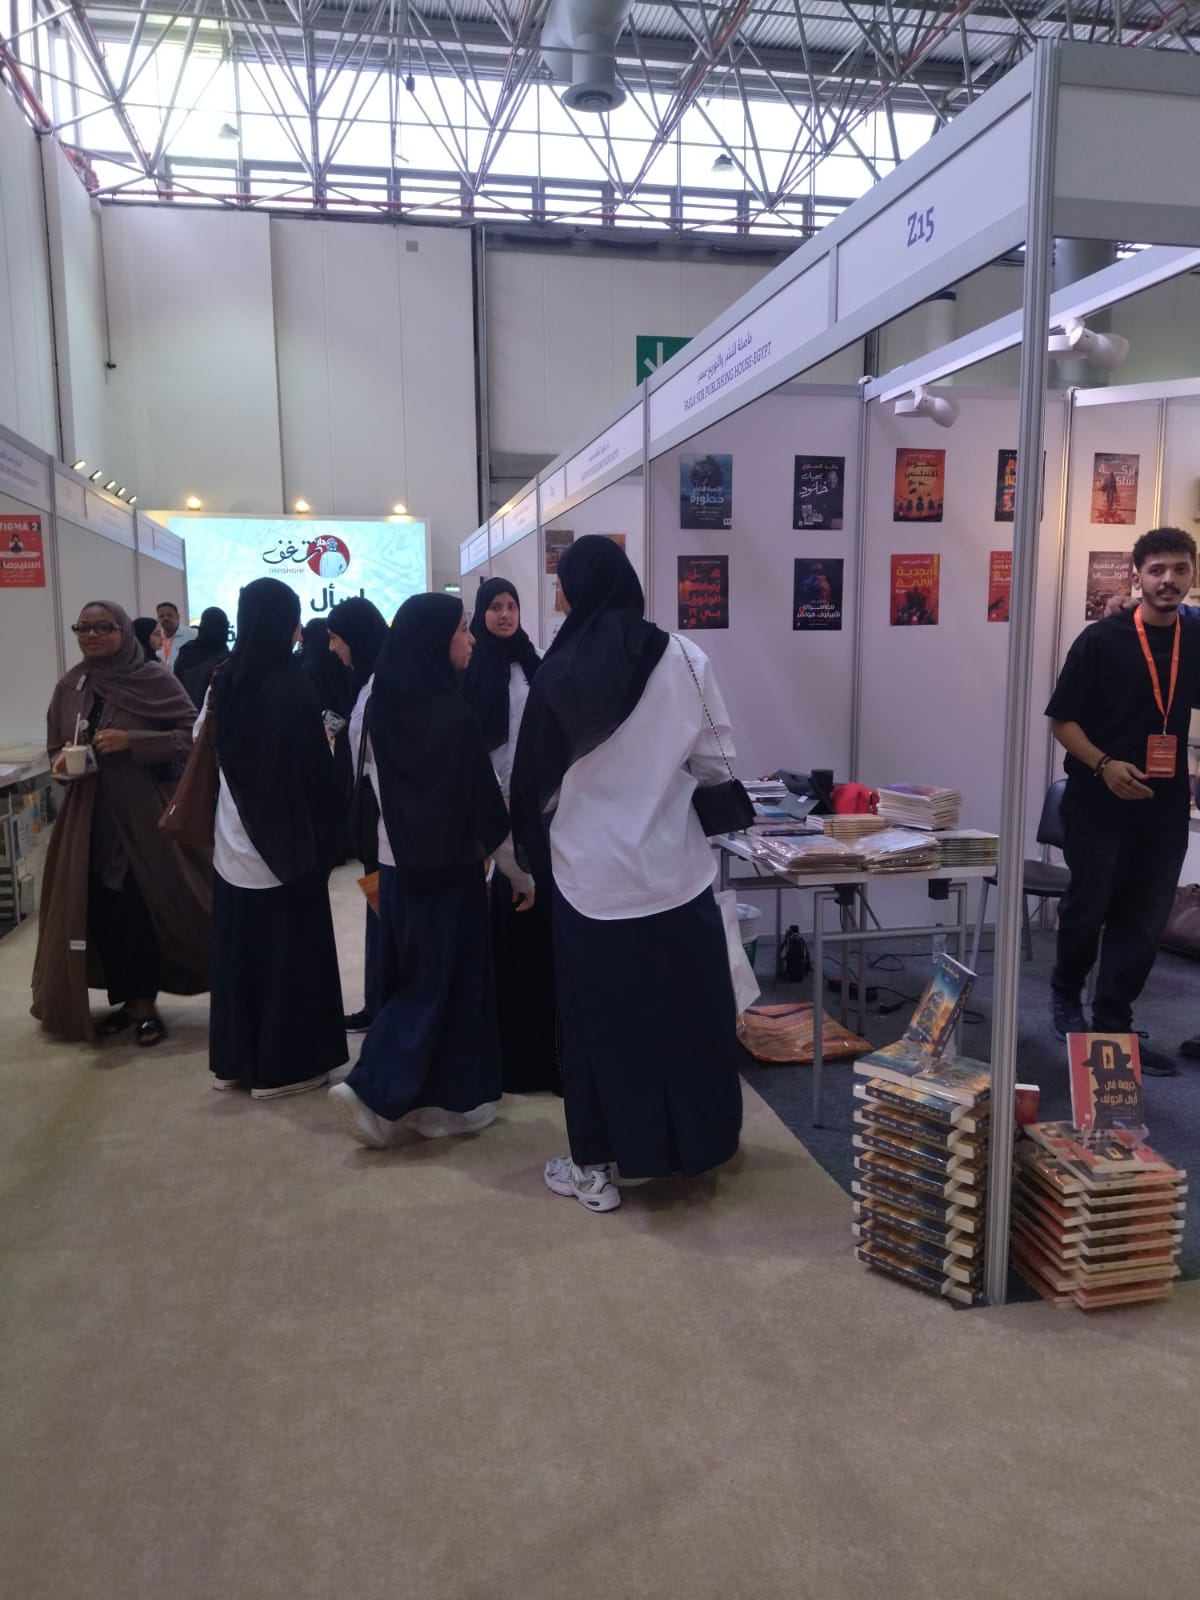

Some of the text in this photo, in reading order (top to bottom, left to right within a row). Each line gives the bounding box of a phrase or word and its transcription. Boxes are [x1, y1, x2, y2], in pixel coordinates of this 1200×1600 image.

[907, 206, 934, 248] Z15
[696, 388, 705, 402] FOR
[705, 367, 734, 396] PUBLISHING
[32, 522, 38, 531] 2
